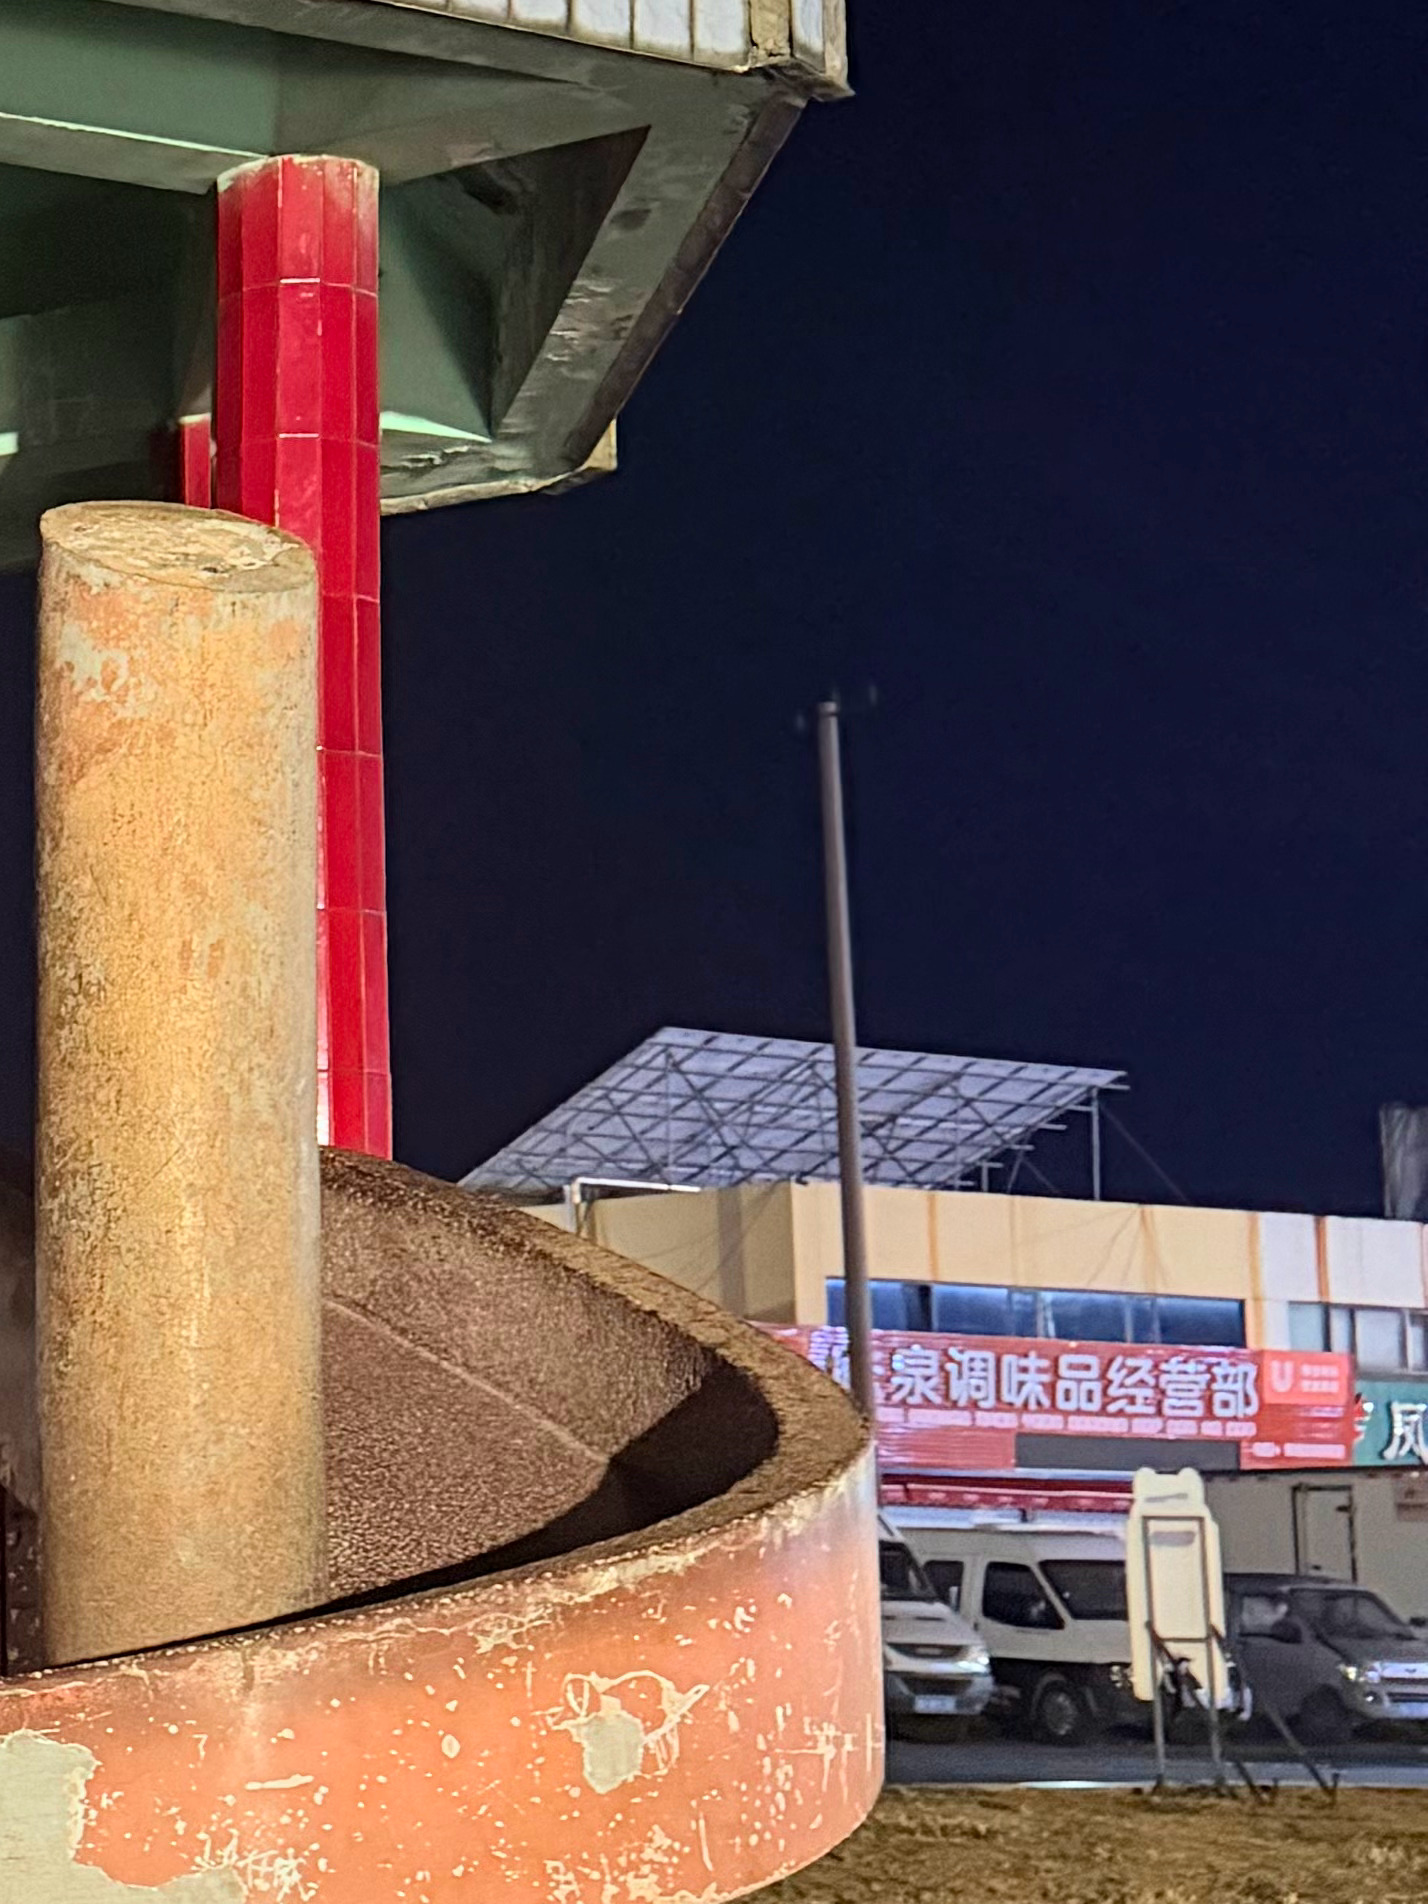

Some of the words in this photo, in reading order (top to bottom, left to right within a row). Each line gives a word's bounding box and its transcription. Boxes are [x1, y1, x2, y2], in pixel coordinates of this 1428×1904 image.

[808, 1328, 1260, 1418] 泉调味品经营部
